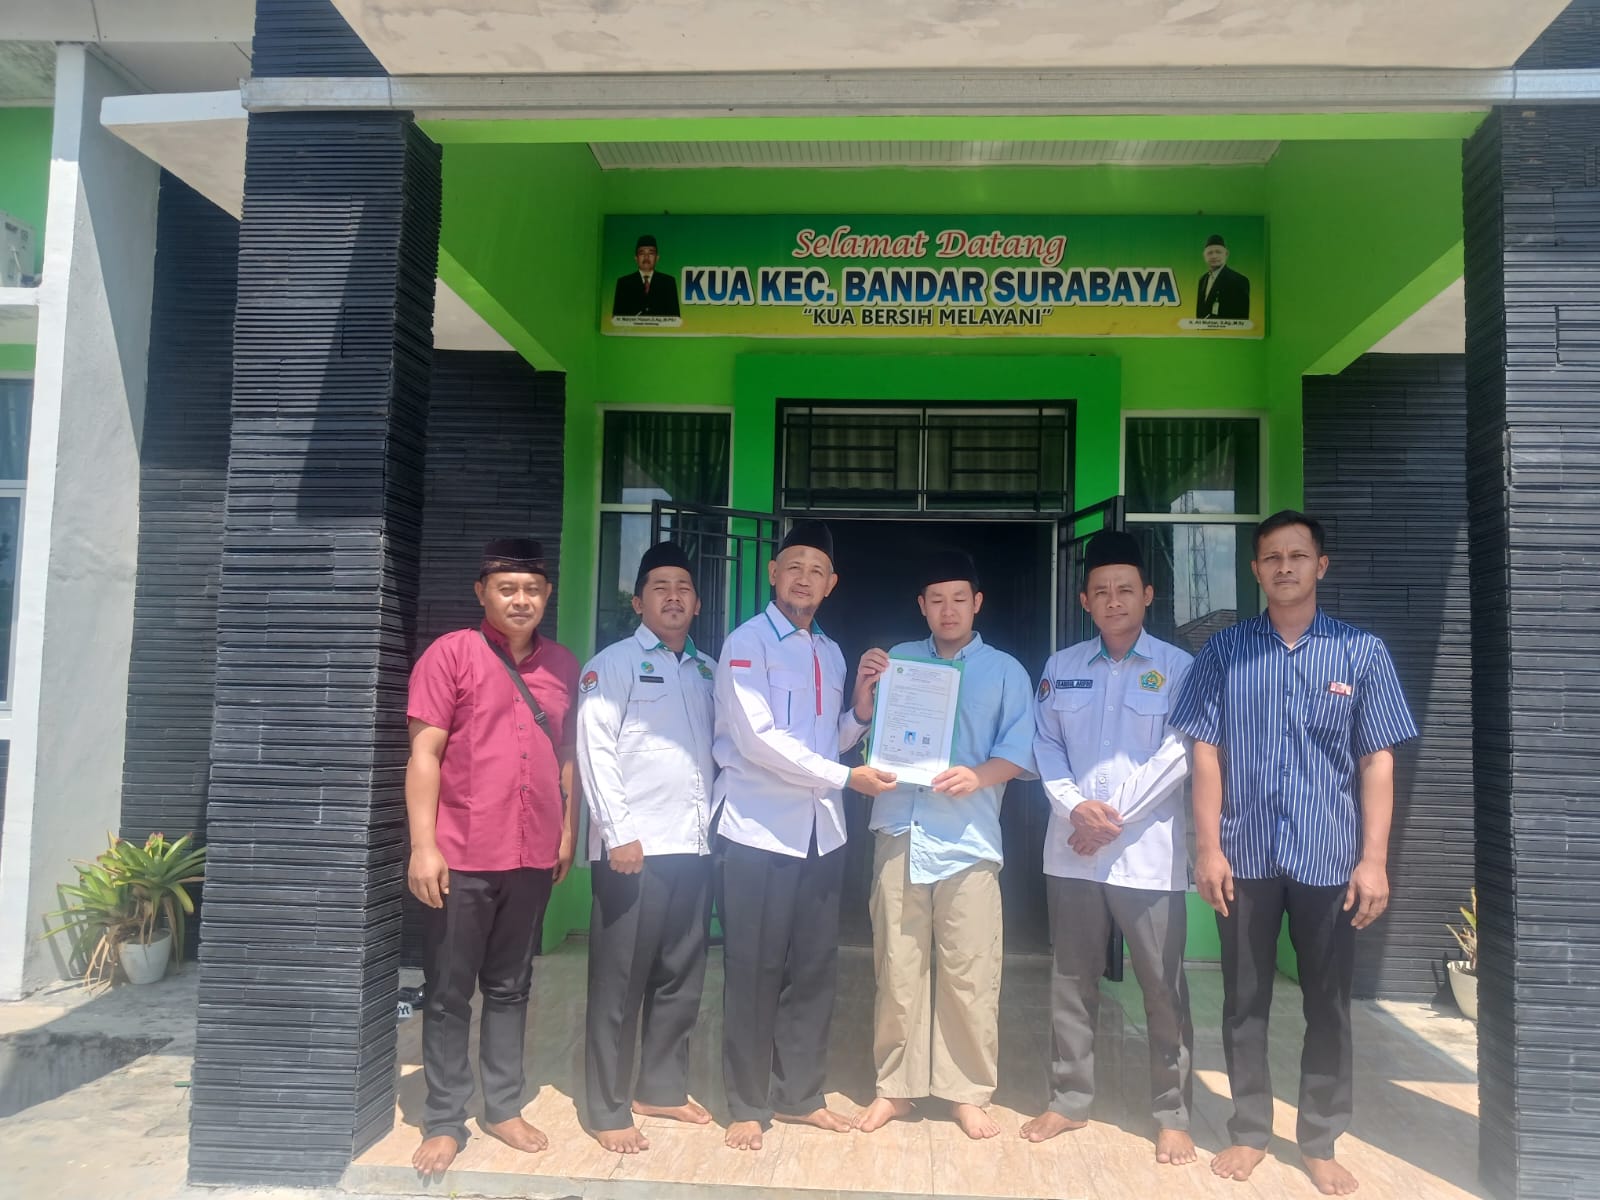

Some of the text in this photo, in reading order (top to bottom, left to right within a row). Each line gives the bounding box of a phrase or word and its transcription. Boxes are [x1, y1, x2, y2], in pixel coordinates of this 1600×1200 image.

[793, 226, 1067, 266] Selamat Datang
[683, 268, 1179, 305] KUA KEC. BANDAR SURABAYA
[861, 308, 932, 325] BERSIH
